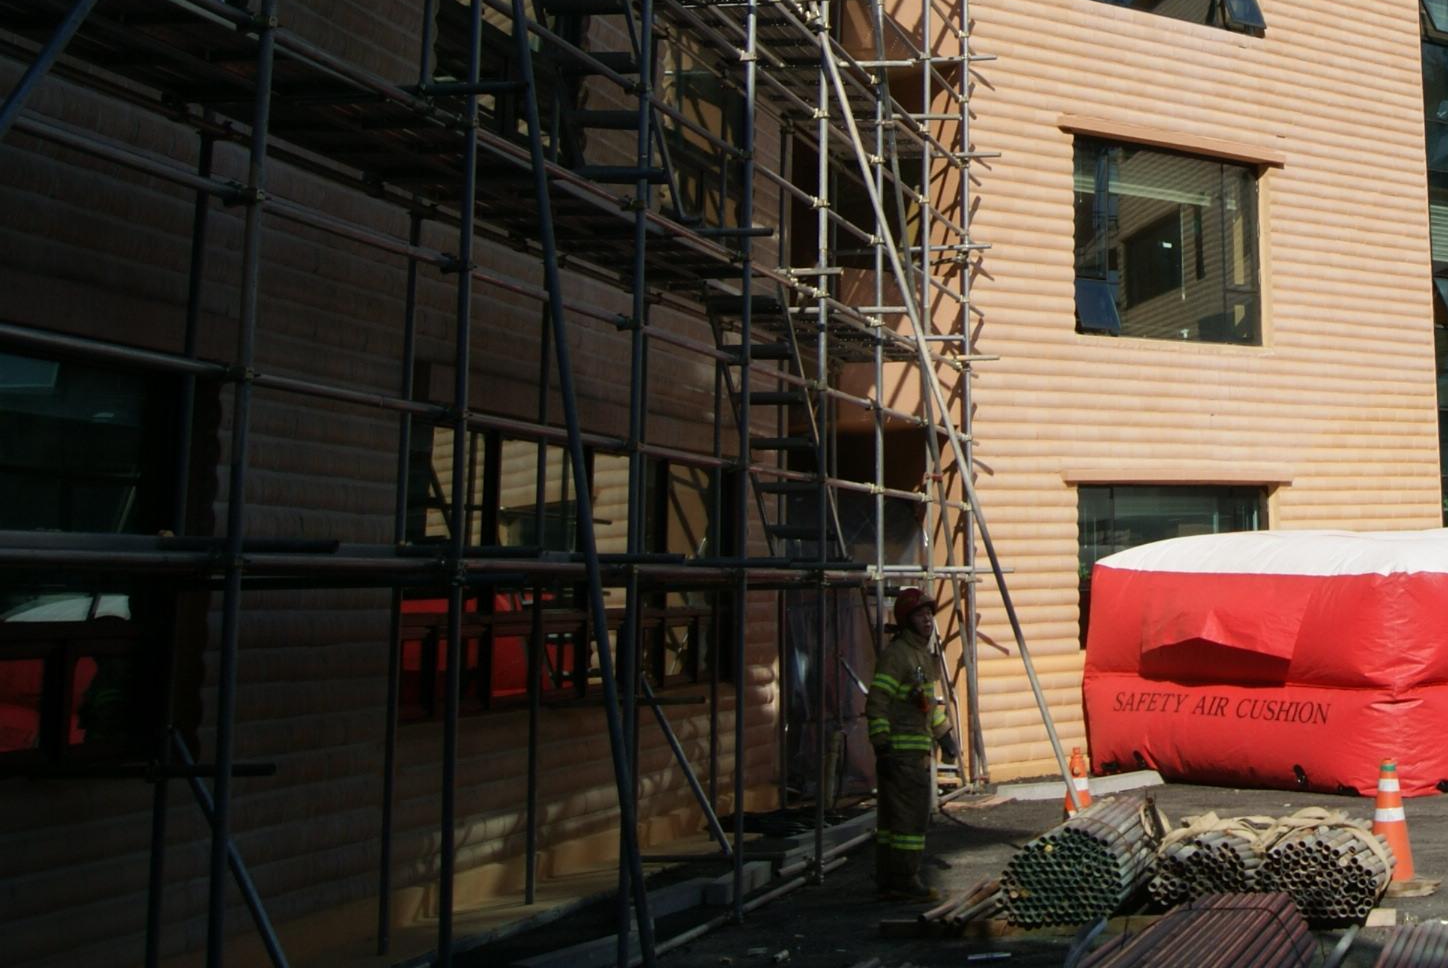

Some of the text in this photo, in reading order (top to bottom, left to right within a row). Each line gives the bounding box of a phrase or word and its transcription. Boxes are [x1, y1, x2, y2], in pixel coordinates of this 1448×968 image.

[1113, 691, 1332, 724] SAFETY AIR CUSHION
